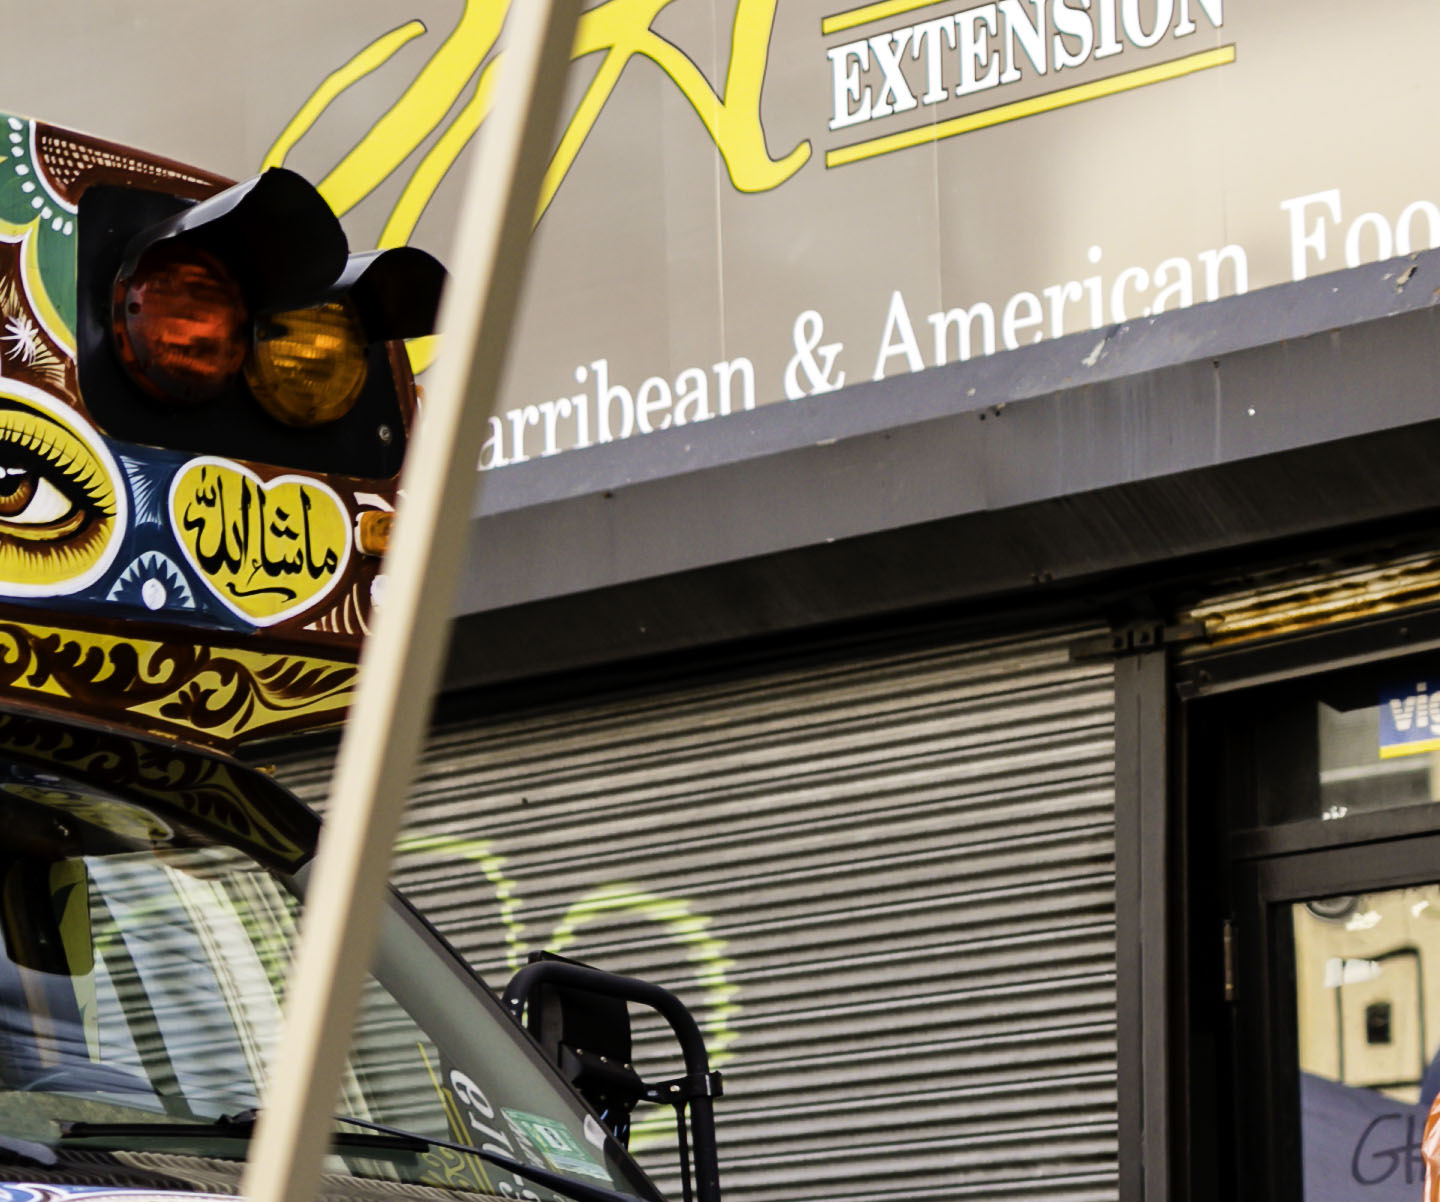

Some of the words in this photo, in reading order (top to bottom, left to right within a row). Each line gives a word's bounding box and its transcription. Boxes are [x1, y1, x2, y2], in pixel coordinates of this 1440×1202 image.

[826, 0, 1227, 132] EXTENSION
[477, 354, 760, 471] arribean
[782, 309, 847, 402] &
[872, 242, 1251, 378] American
